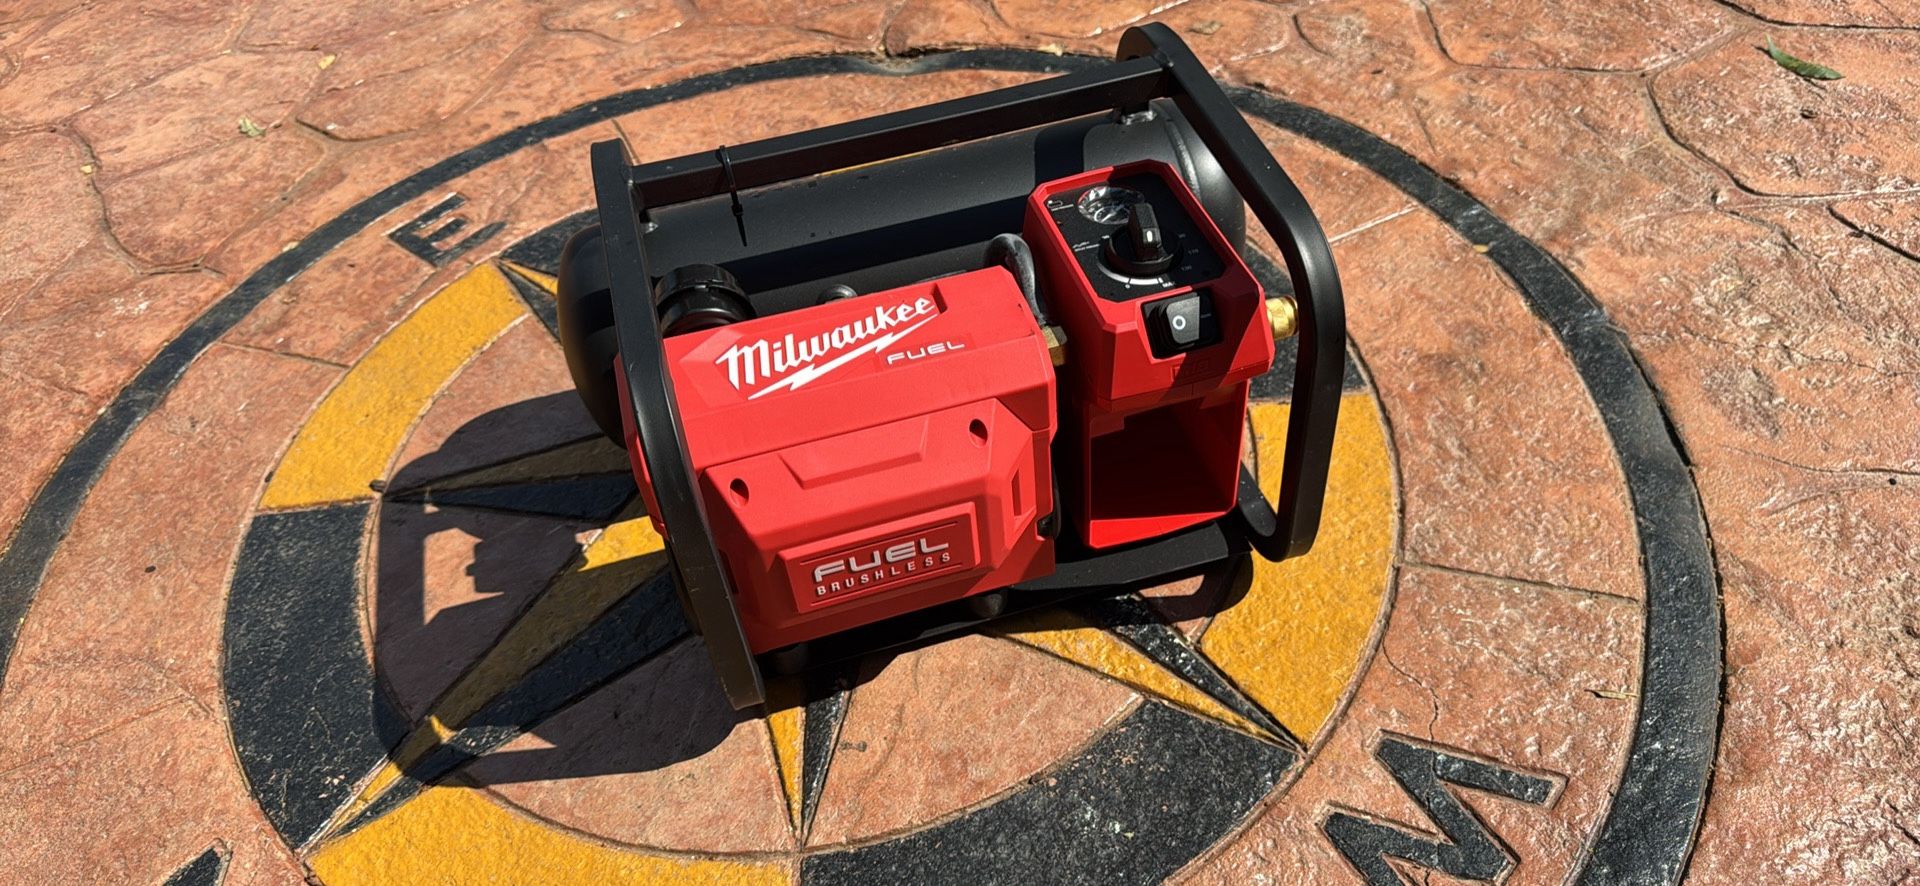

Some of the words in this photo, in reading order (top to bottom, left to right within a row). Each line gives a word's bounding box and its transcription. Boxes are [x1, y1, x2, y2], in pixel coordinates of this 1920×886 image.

[389, 193, 507, 268] E
[715, 296, 936, 391] Milwaukee
[887, 340, 965, 366] FUEL
[813, 537, 949, 582] FUEL
[815, 552, 951, 596] BRUSHLESS
